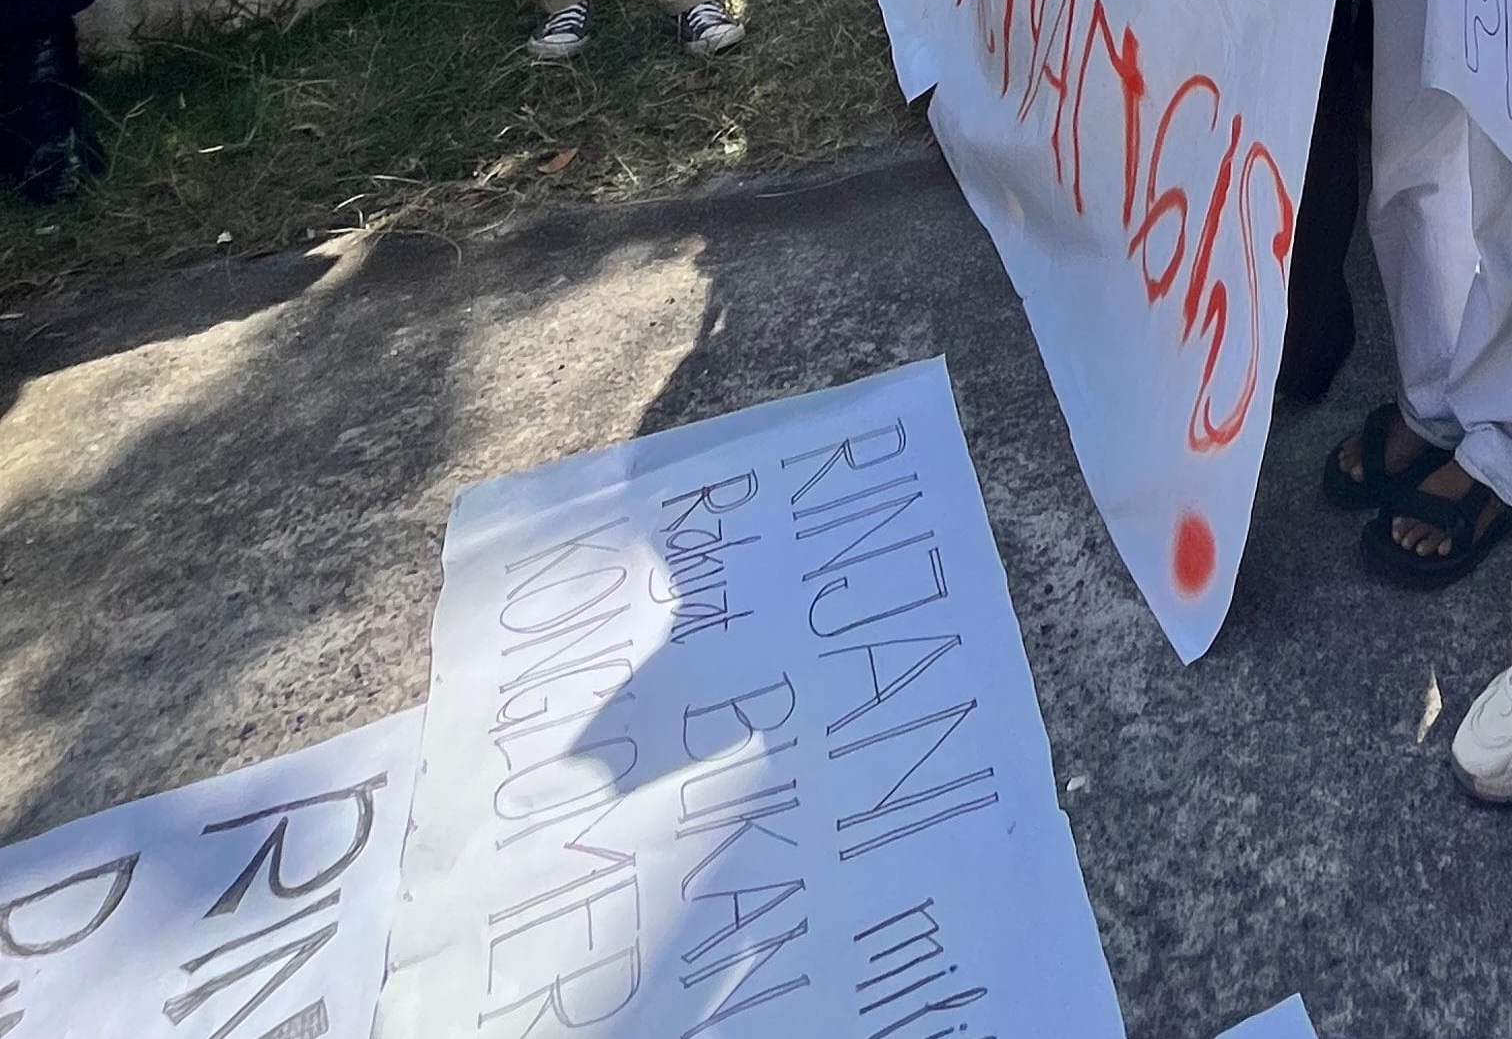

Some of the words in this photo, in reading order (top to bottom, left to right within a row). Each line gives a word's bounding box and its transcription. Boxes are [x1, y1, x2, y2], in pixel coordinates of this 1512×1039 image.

[648, 468, 762, 645] Rakyat
[780, 416, 1000, 862] RINJANI
[675, 671, 811, 1039] BUKAN
